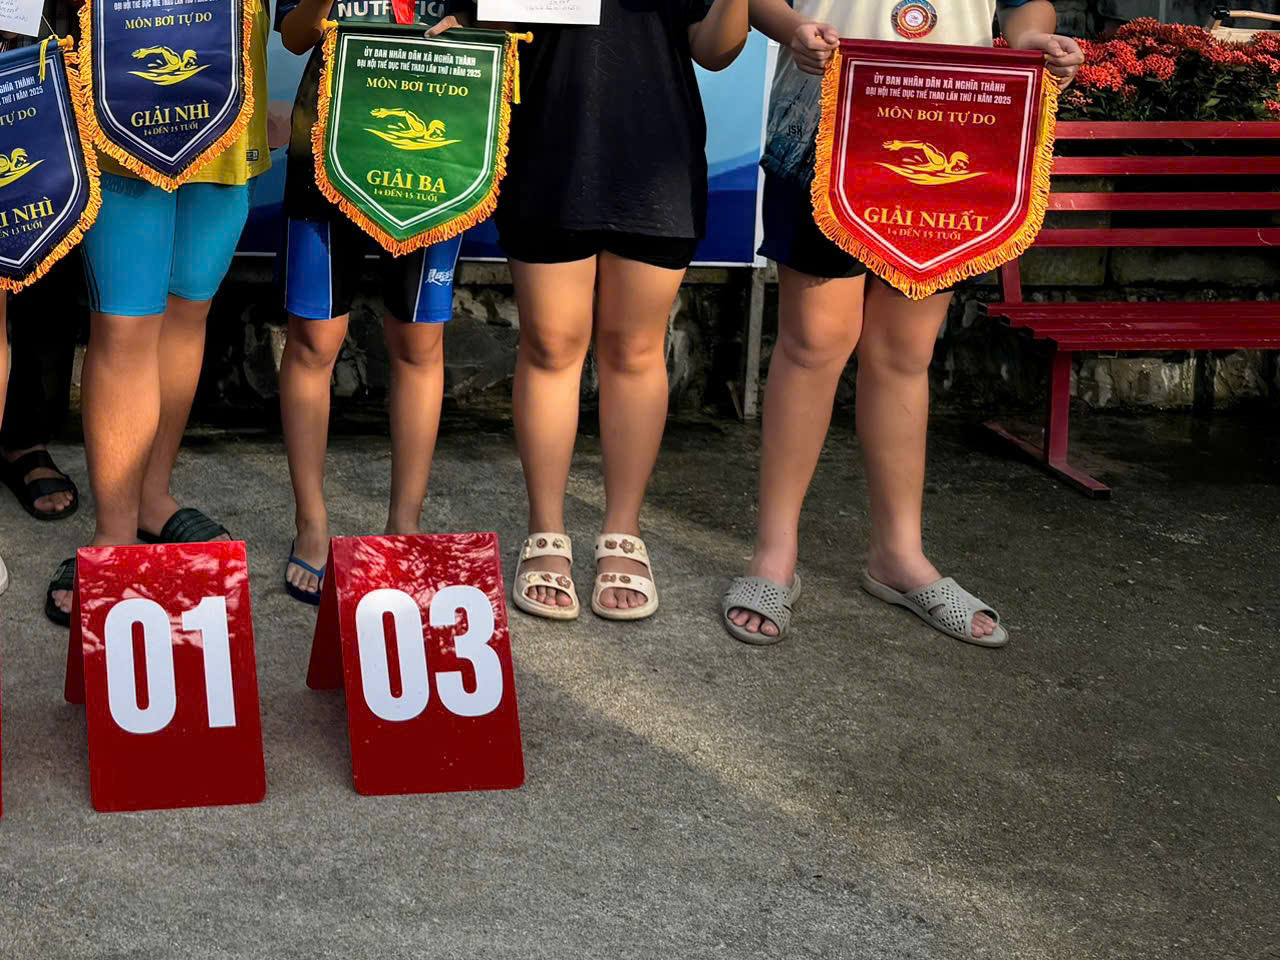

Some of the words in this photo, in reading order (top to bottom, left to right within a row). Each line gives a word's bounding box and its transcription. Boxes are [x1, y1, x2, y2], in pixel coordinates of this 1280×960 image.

[125, 16, 153, 29] MÔN
[155, 14, 177, 26] BƠI
[178, 12, 194, 26] TỰ
[195, 12, 212, 23] DO
[366, 77, 398, 89] MÔN
[401, 80, 424, 91] BƠI
[427, 82, 447, 97] TỰ
[448, 85, 469, 97] DO
[886, 76, 901, 85] BAN
[18, 107, 37, 121] DO
[131, 106, 171, 128] GIẢI
[175, 99, 211, 122] NHÌ
[877, 106, 913, 119] MÔN
[917, 108, 943, 121] BƠI
[947, 110, 970, 126] TỰ
[972, 113, 996, 125] DO
[366, 168, 412, 189] GIẢI
[419, 175, 447, 193] BA
[13, 197, 55, 223] NHÌ
[864, 205, 913, 227] GIẢI
[919, 209, 989, 232] NHẤT
[104, 595, 236, 734] 01
[355, 585, 504, 722] 03
